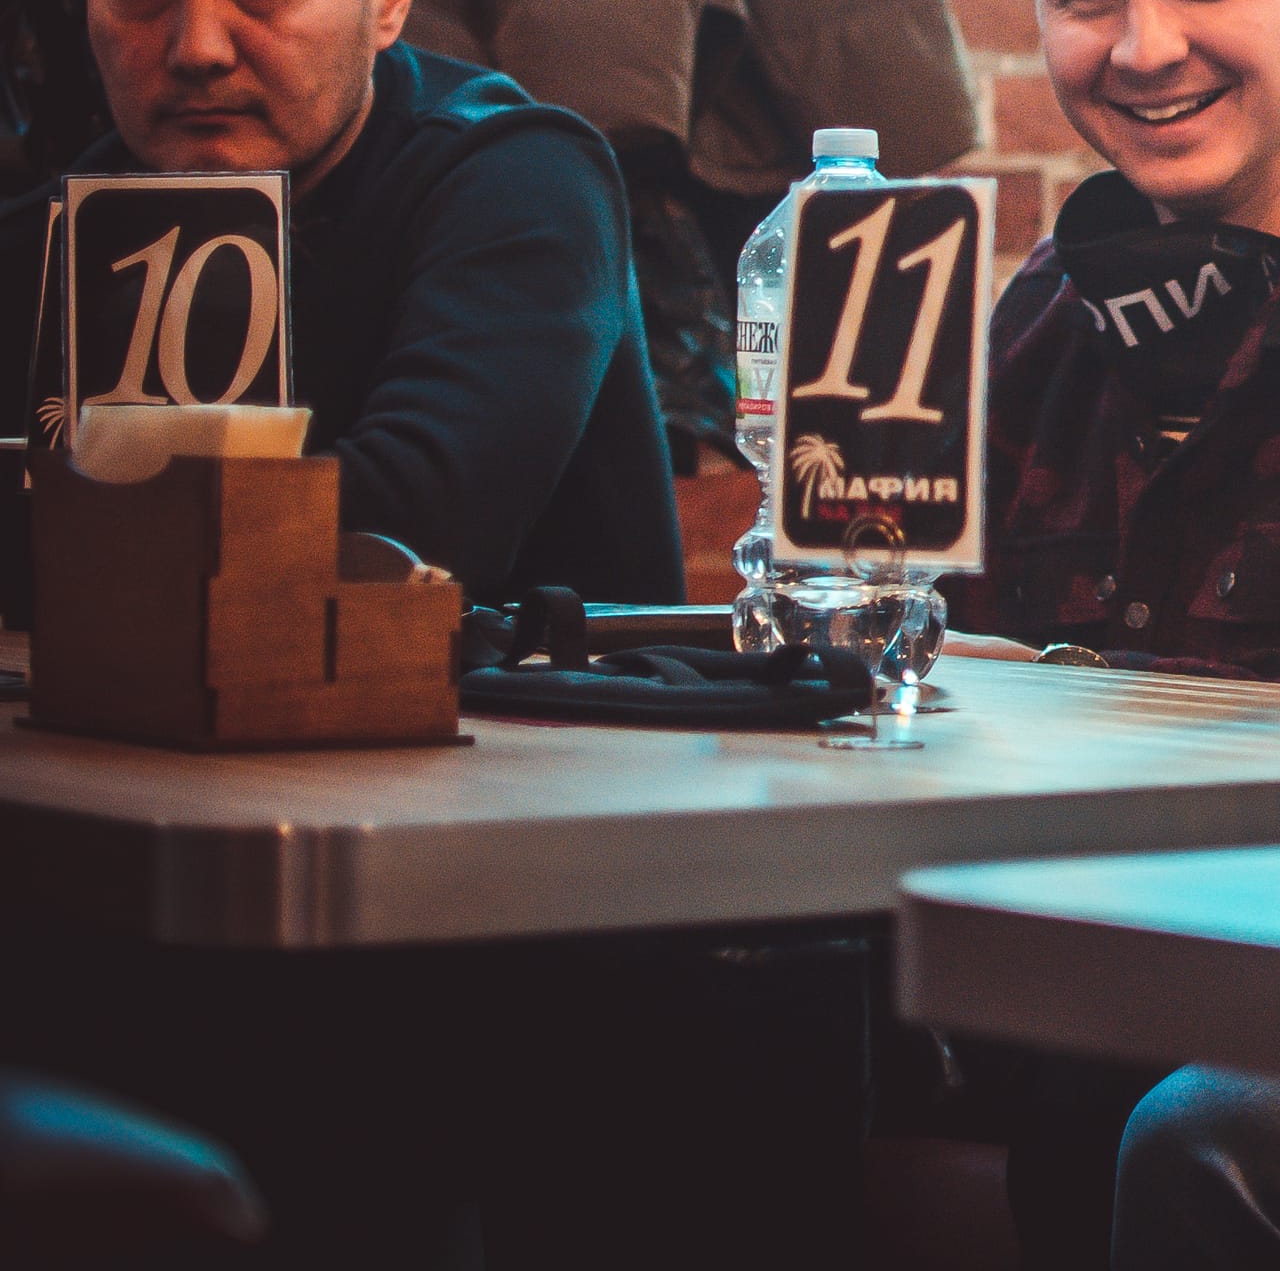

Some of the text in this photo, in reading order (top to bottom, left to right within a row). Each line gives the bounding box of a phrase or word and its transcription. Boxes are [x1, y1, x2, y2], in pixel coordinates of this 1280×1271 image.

[84, 226, 278, 406] 10
[792, 197, 966, 423] 11
[818, 476, 958, 503] МАФИЯ
